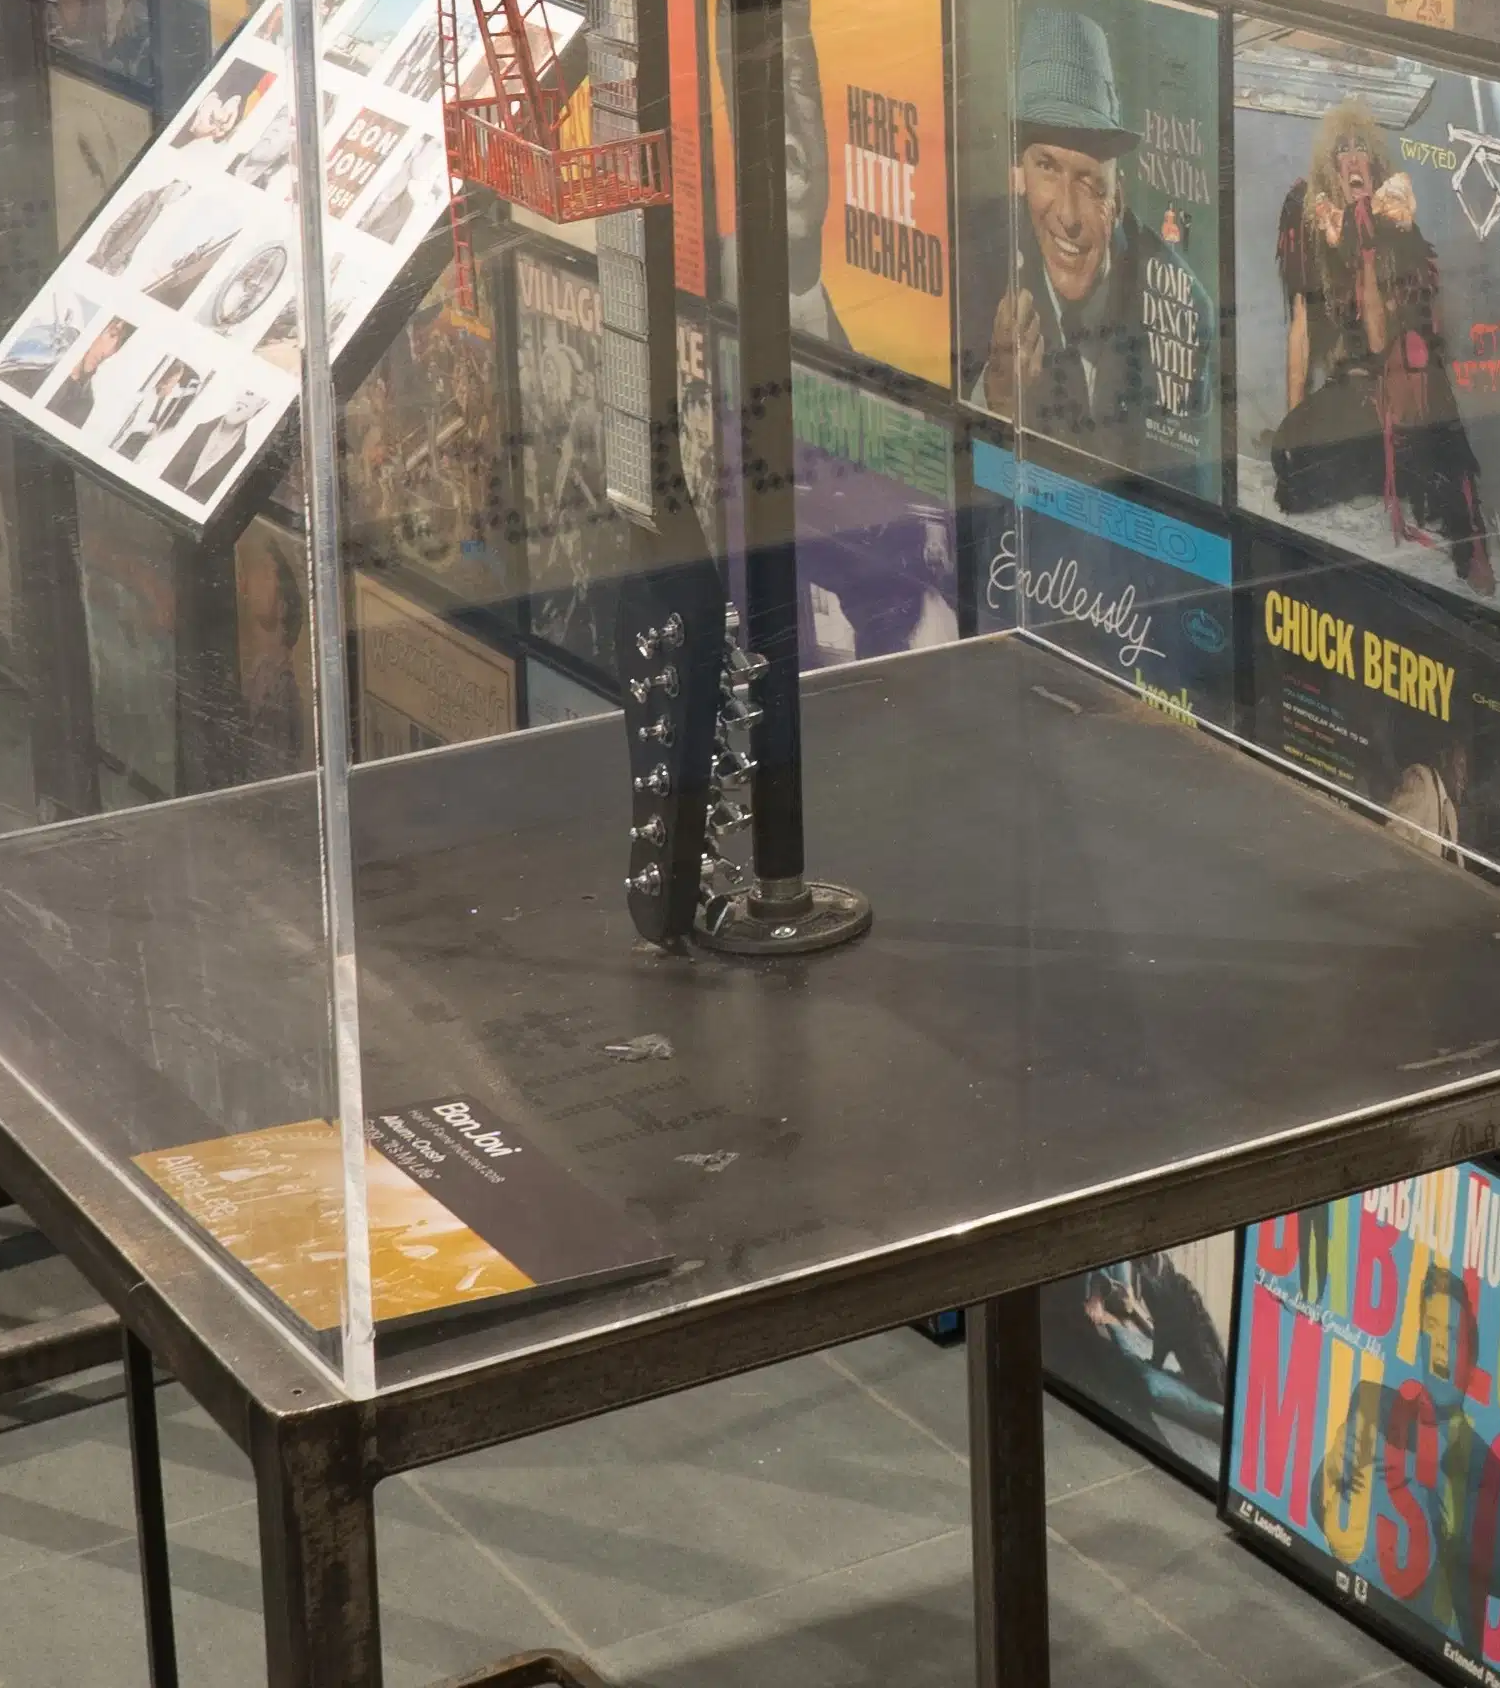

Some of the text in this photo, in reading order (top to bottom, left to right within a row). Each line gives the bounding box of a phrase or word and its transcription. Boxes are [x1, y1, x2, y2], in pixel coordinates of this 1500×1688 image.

[344, 118, 399, 155] BON
[846, 83, 920, 167] HERE'S
[1144, 108, 1204, 157] FRANK
[1138, 151, 1212, 205] SINATRA
[1400, 137, 1457, 172] TWISTED
[844, 143, 917, 229] LITTLE
[844, 203, 944, 297] RICHARD
[1146, 256, 1195, 308] COME
[1143, 290, 1199, 348] DANCE
[1147, 330, 1197, 384] WITH
[1145, 417, 1175, 439] BILLY
[1178, 429, 1201, 447] MAY
[1001, 457, 1197, 564] STEREO
[987, 530, 1167, 667] Endlessly
[1264, 589, 1455, 722] CHUCK BERRY
[413, 1136, 447, 1164] Crush
[432, 1101, 522, 1159] Bon Jovi
[1254, 1508, 1292, 1549] LaserDisc
[1444, 1642, 1483, 1679] Extended
